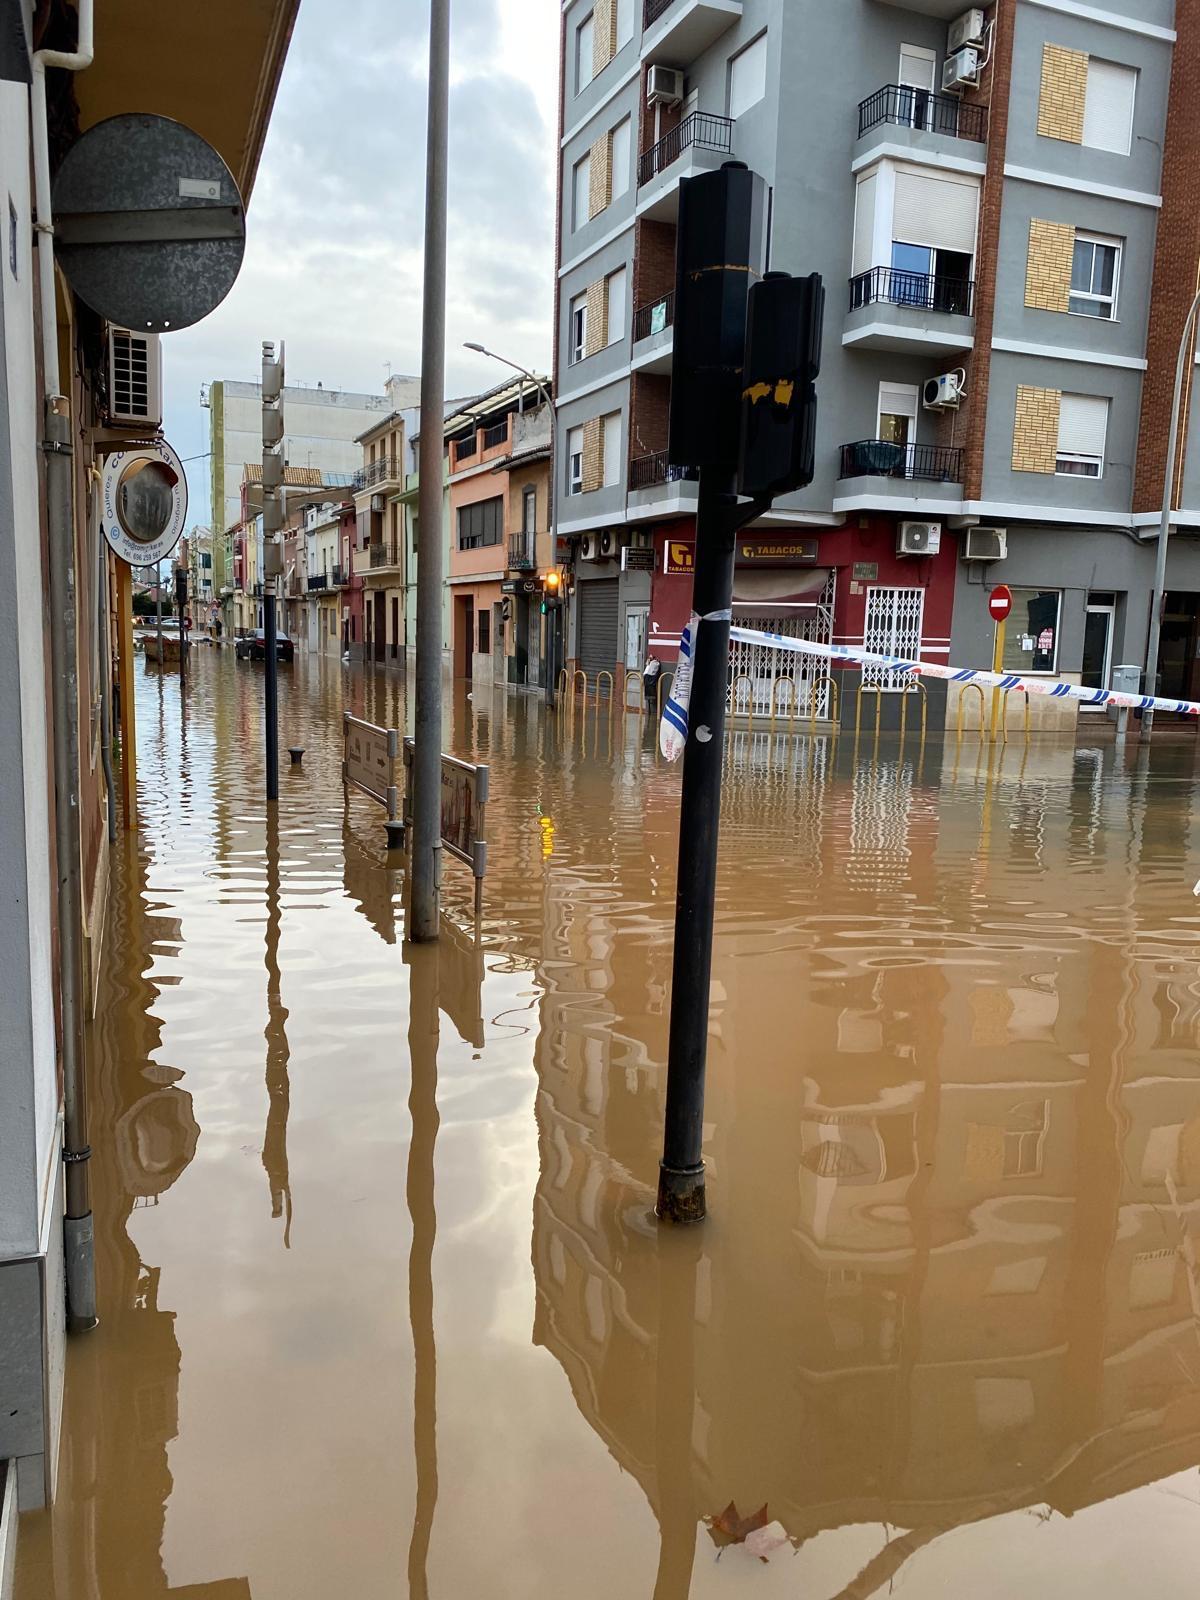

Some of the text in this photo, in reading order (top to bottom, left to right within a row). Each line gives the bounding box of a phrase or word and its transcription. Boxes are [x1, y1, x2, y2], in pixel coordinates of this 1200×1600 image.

[105, 475, 113, 519] Quieres
[171, 497, 181, 535] negocio
[757, 546, 803, 554] TABACOS
